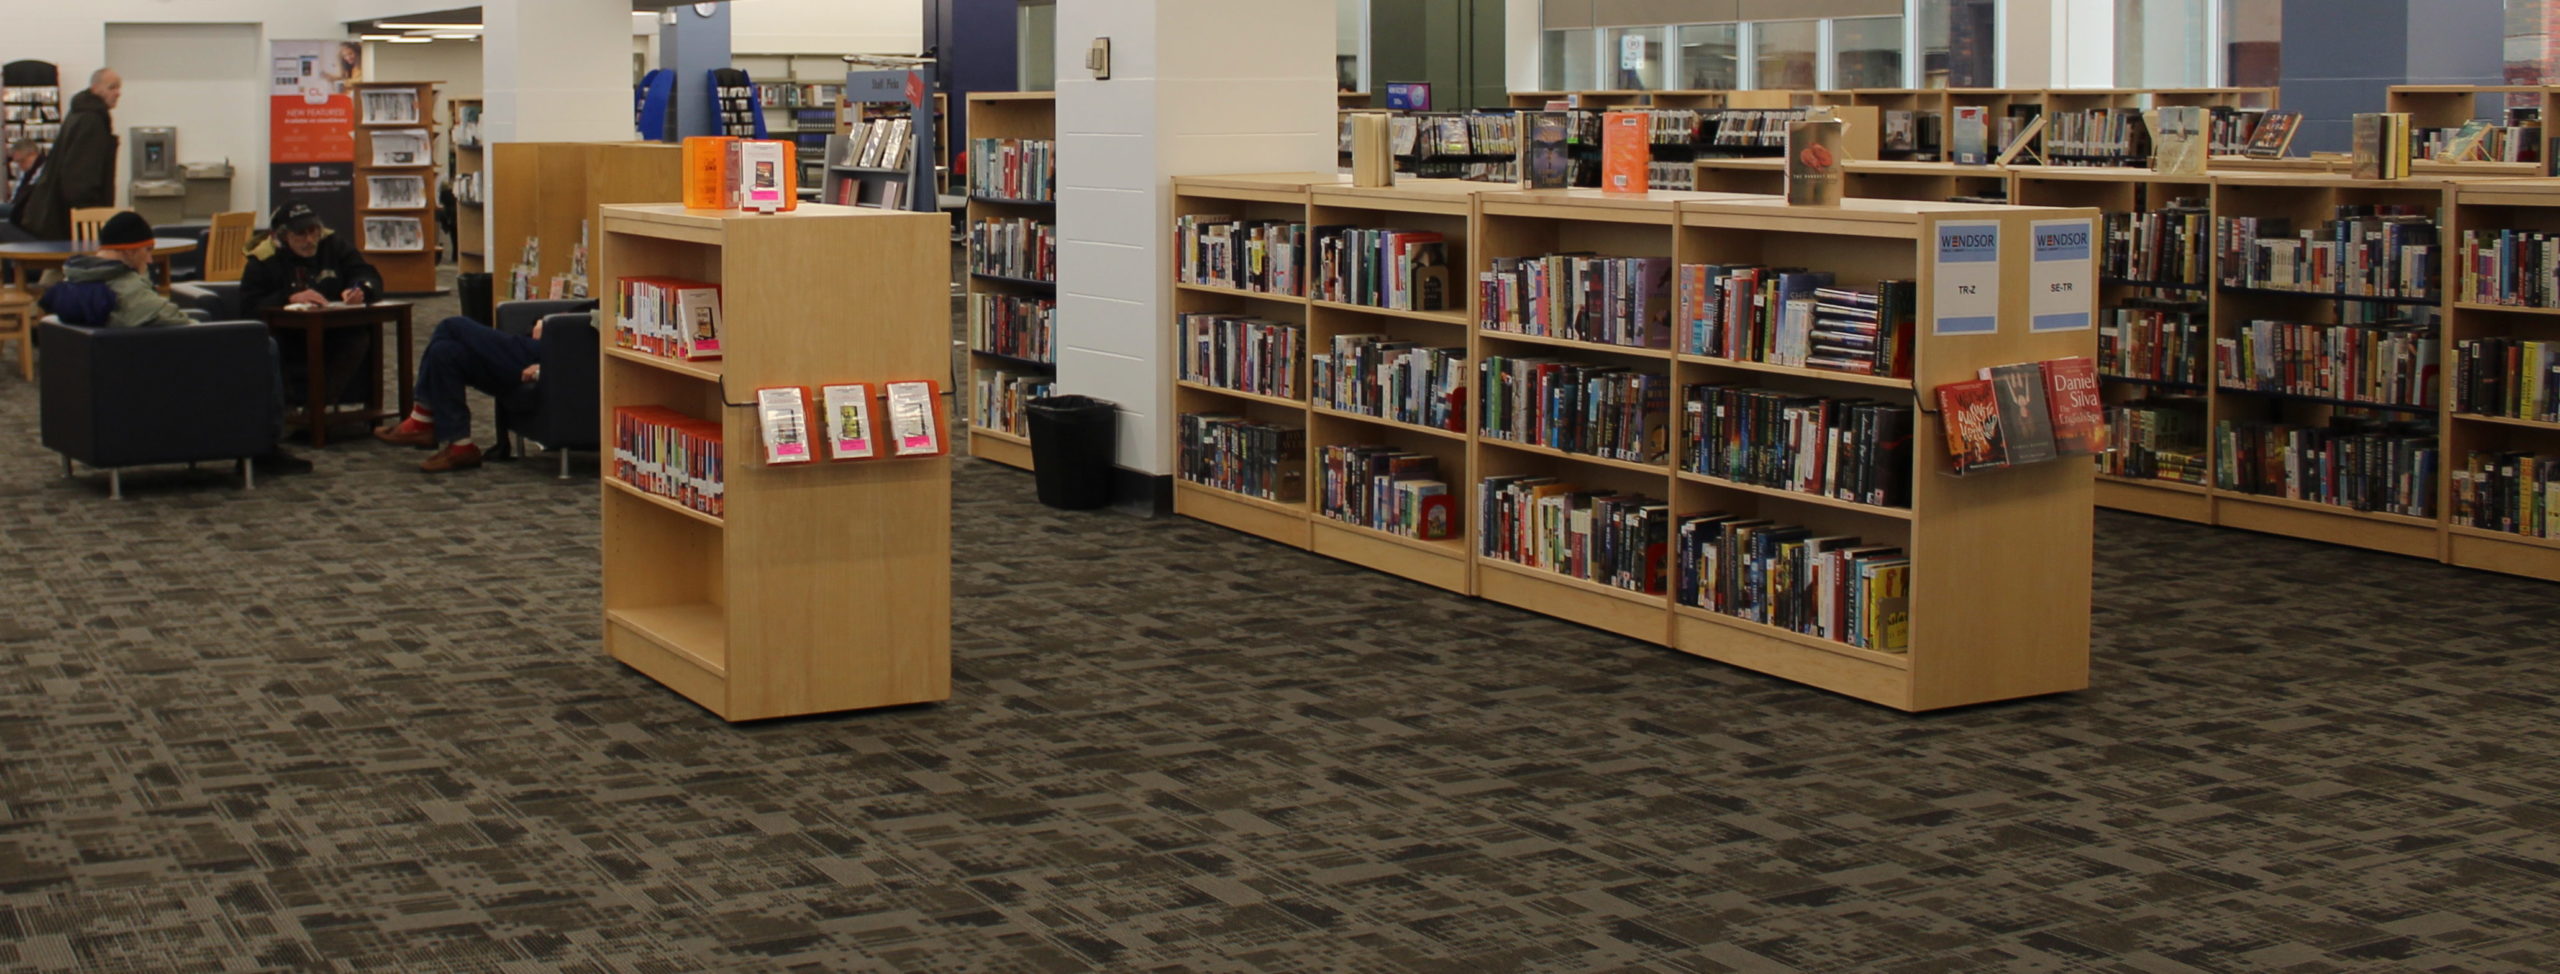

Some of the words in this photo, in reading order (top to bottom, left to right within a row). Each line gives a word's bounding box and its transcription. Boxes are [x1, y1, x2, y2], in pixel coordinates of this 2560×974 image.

[1941, 234, 1995, 248] WINDSOR
[2037, 232, 2088, 247] WINDSOR
[1958, 285, 1976, 295] TR-Z
[2050, 283, 2073, 293] SE-TR
[2054, 373, 2096, 392] Daniel
[2070, 390, 2098, 408] Silva
[2059, 412, 2085, 426] English
